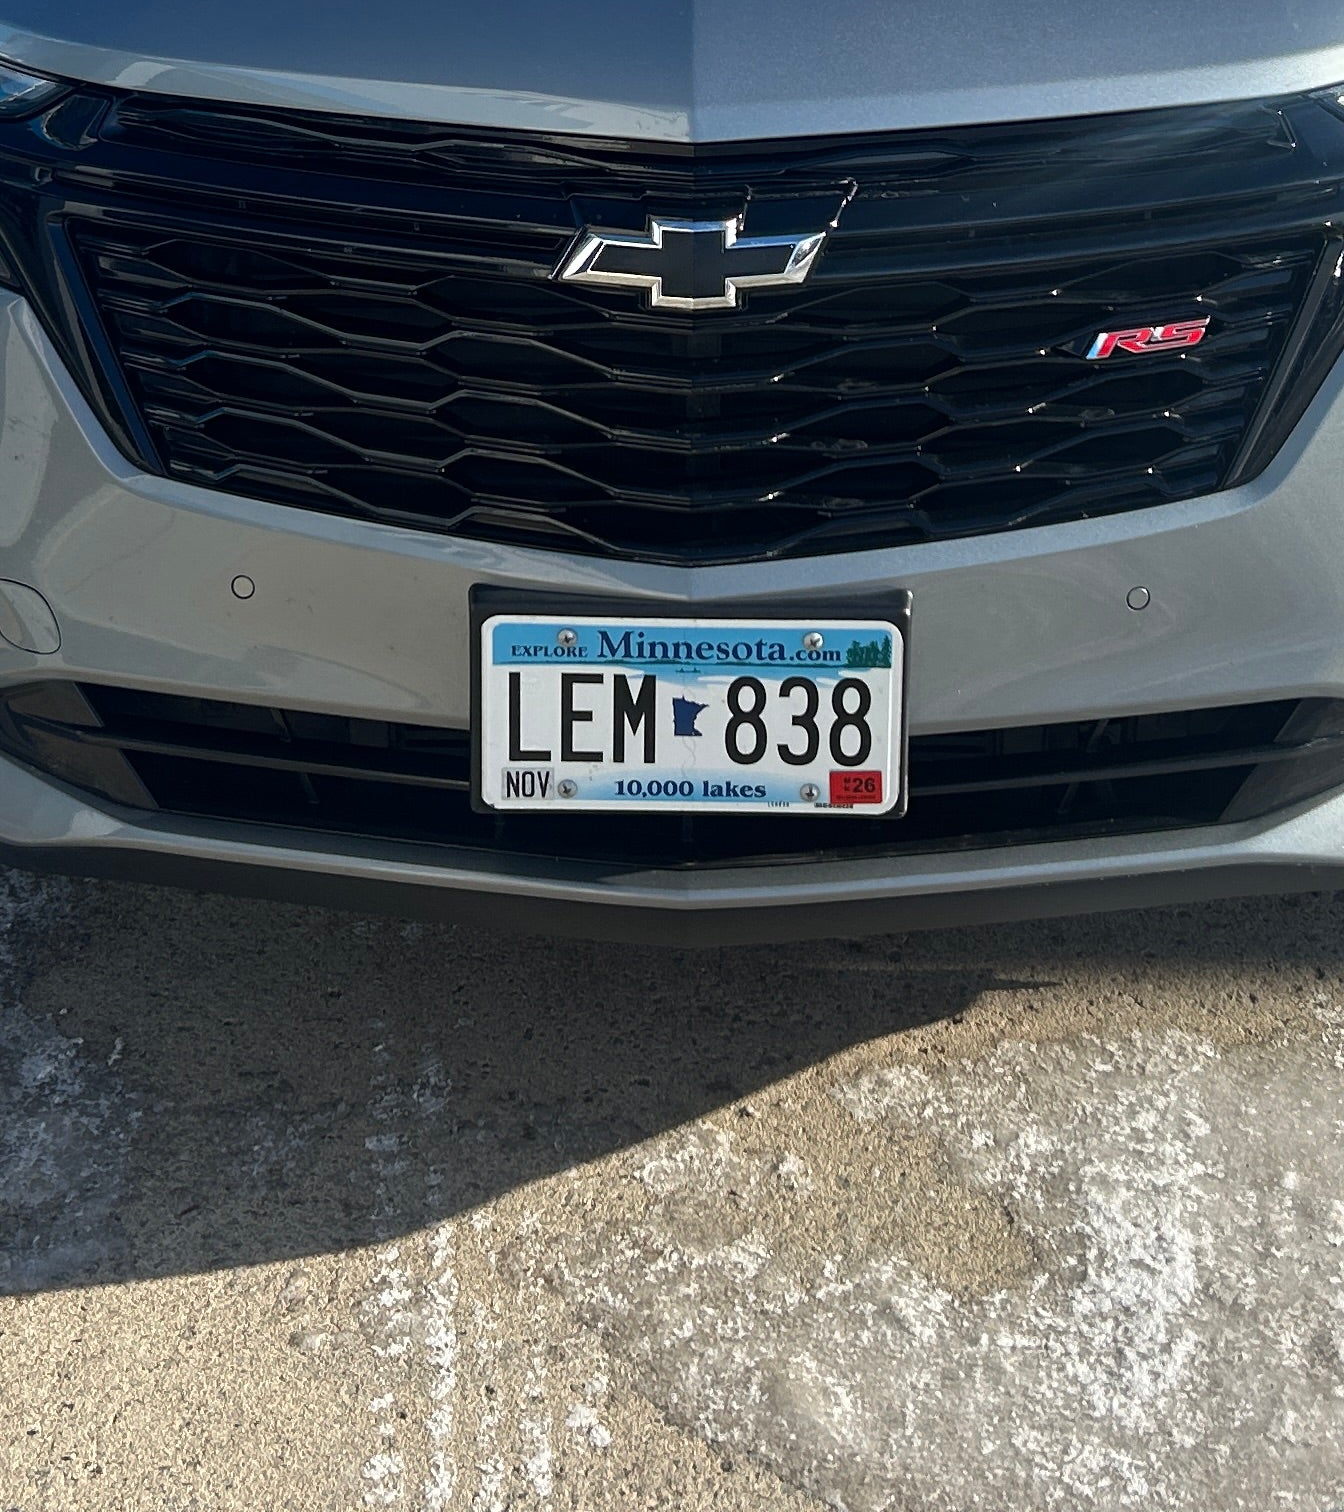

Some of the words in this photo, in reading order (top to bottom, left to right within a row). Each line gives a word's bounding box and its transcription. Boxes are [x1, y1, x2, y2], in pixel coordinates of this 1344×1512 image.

[1087, 315, 1211, 360] RS
[511, 645, 588, 658] EXPLORE
[597, 629, 842, 662] Minnesota.com
[508, 671, 656, 764] LEM
[724, 675, 872, 767] 838
[506, 770, 550, 798] NOV
[614, 779, 694, 798] 10,000
[702, 780, 767, 798] lakes
[852, 777, 876, 793] 26
